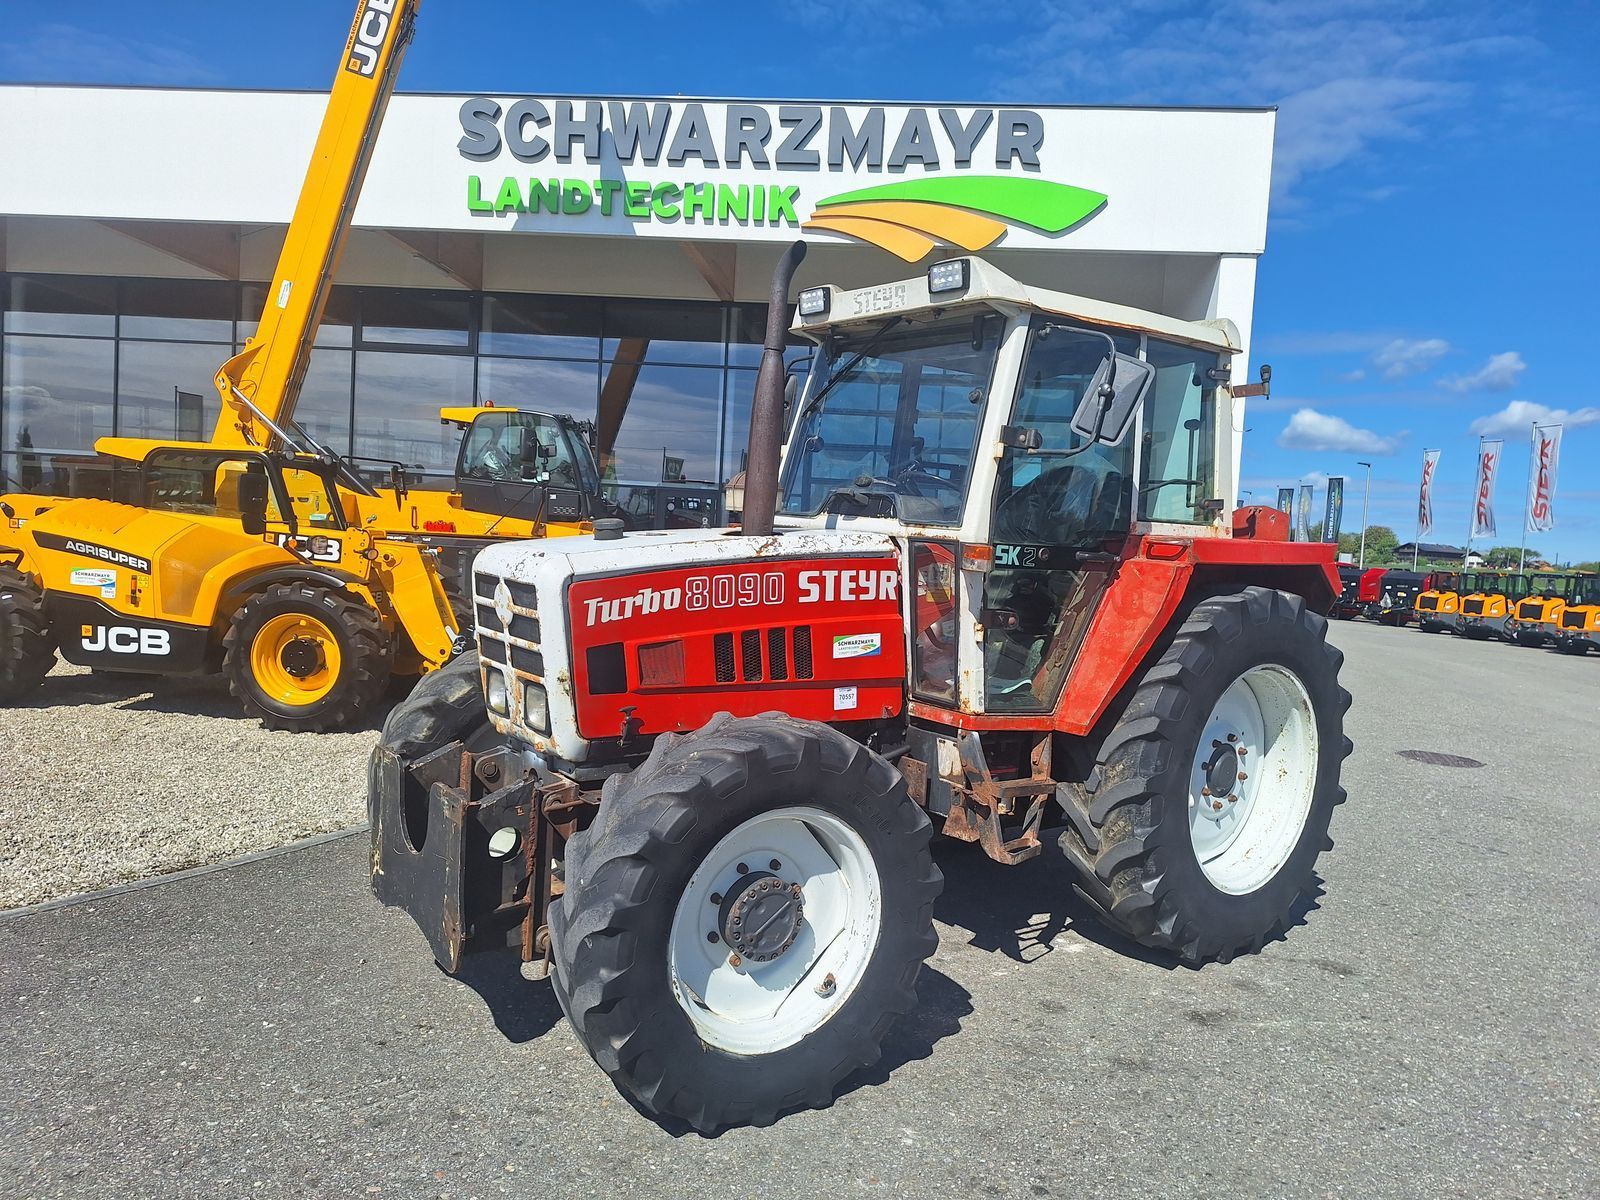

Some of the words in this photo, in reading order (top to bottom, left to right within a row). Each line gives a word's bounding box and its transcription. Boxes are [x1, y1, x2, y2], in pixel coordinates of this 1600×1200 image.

[457, 97, 1045, 172] SCHWARZMAYR
[468, 175, 801, 226] LANDTECHNIK
[853, 285, 906, 315] STEYR
[1477, 453, 1494, 528] STEYR
[1533, 438, 1552, 520] STEYR
[66, 540, 148, 571] AGRISUPER
[995, 544, 1021, 566] SK
[1022, 546, 1037, 567] 2
[583, 587, 681, 627] Turbo
[685, 572, 785, 611] 8090
[798, 570, 898, 603] STEYR
[81, 625, 171, 655] JCB
[839, 693, 855, 701] 70557
